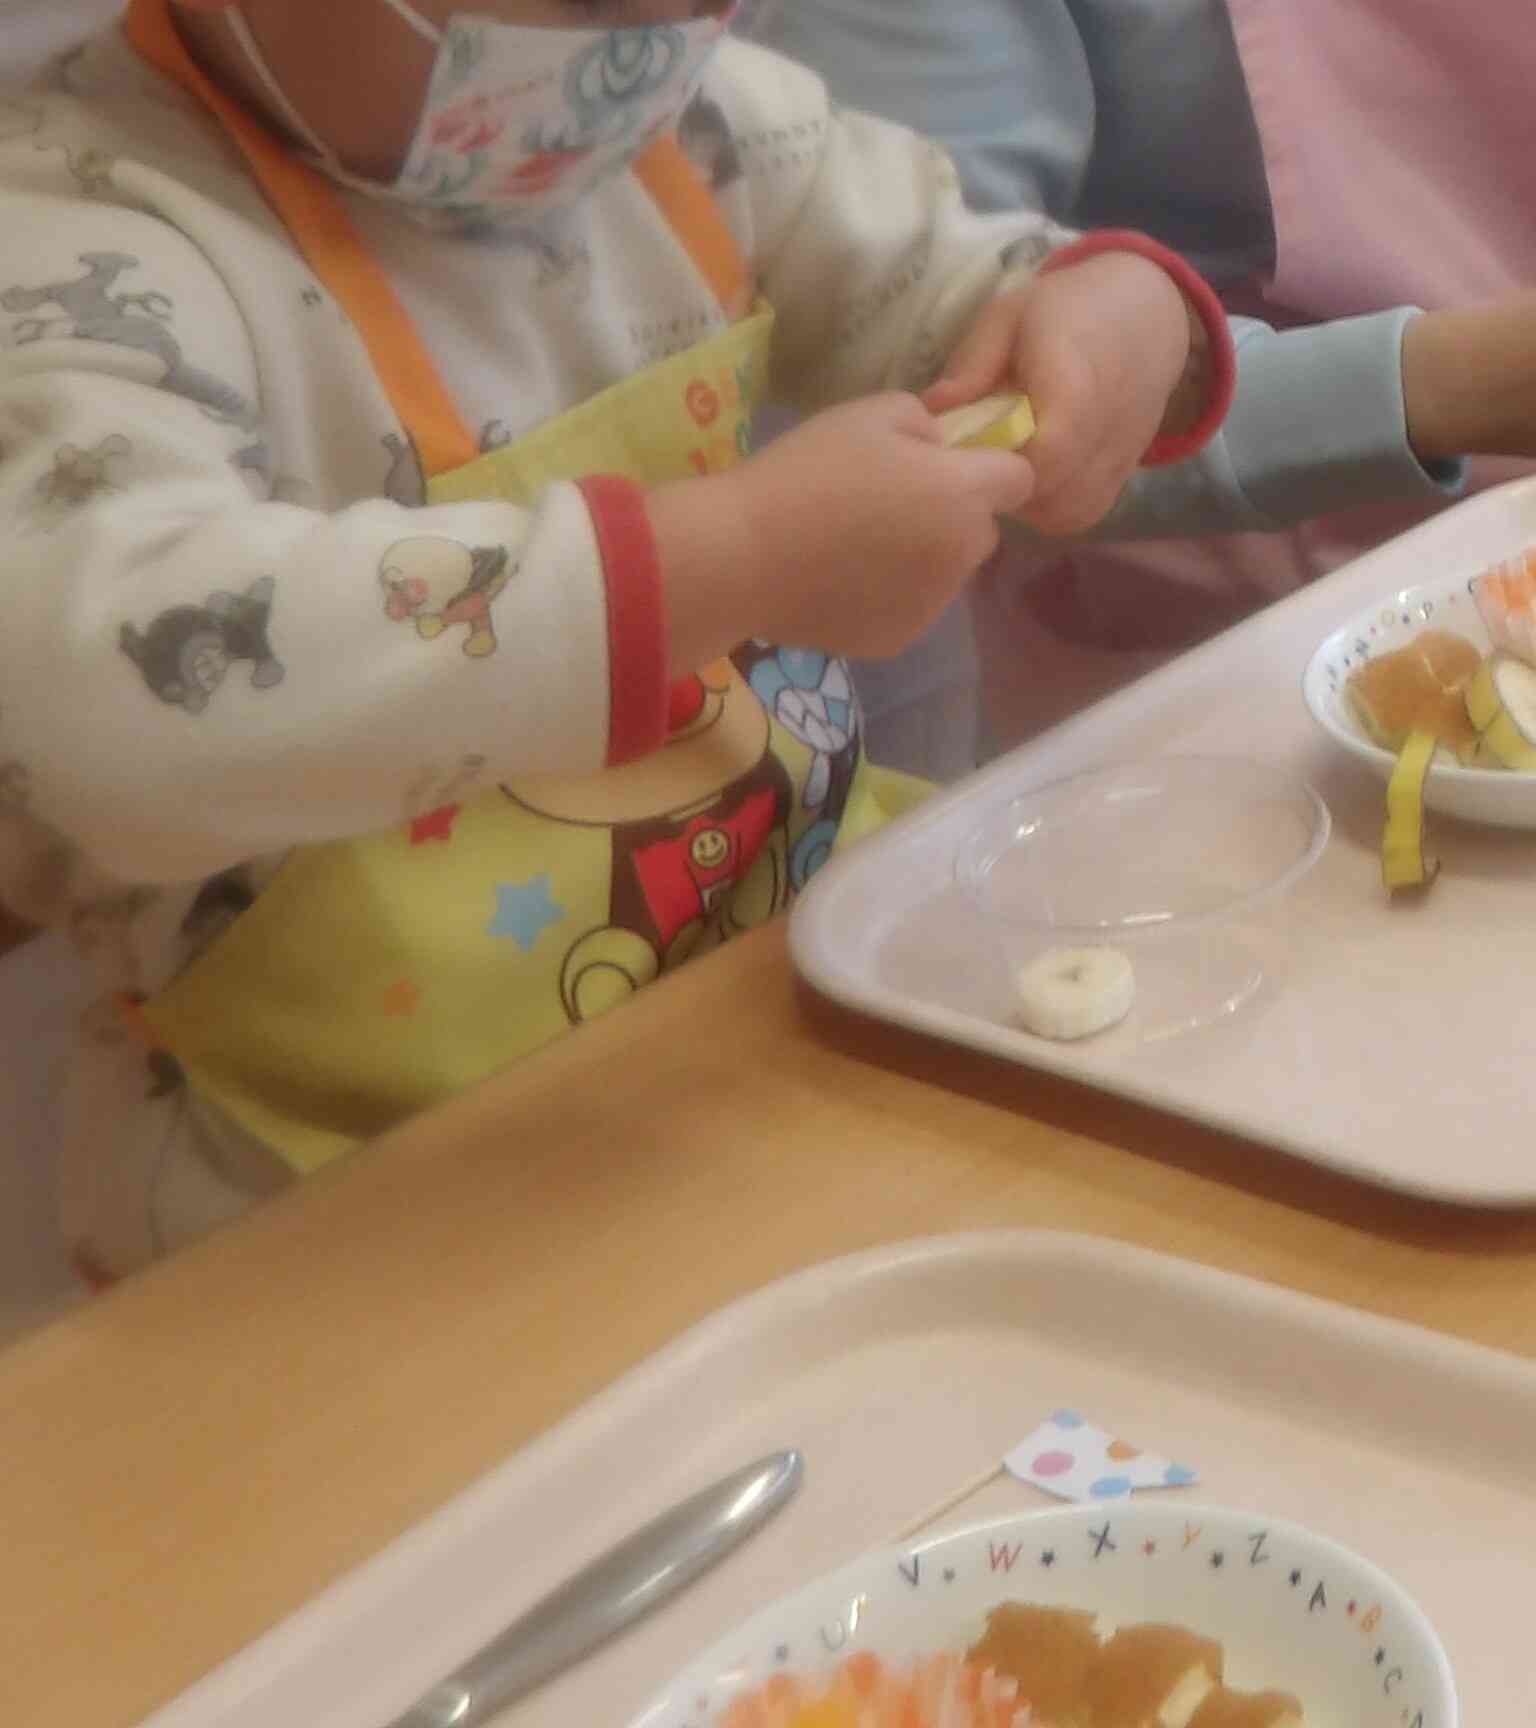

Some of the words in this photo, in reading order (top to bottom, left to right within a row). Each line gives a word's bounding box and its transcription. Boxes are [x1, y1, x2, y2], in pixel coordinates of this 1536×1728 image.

[898, 1553, 920, 1587] V
[989, 1542, 1023, 1572] W
[1088, 1522, 1117, 1558] X
[1181, 1521, 1200, 1549] Y
[1248, 1529, 1271, 1566] Z
[1308, 1581, 1328, 1612] A
